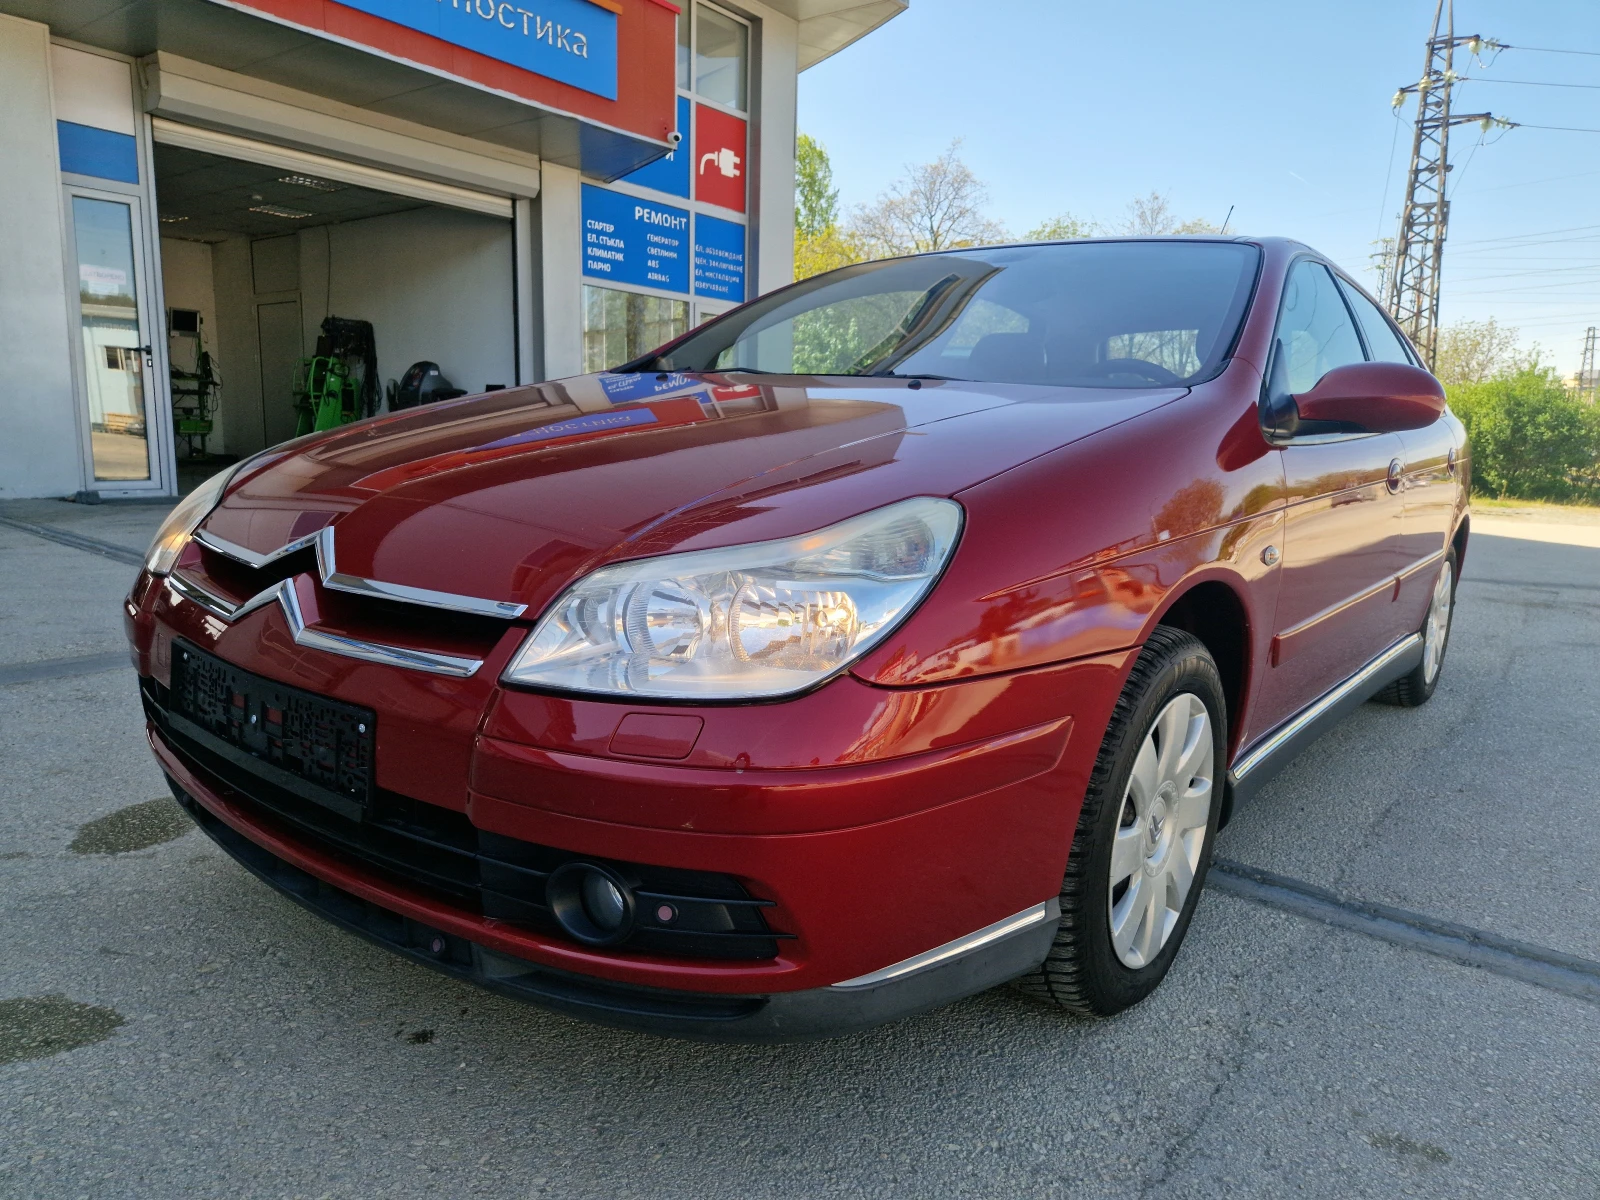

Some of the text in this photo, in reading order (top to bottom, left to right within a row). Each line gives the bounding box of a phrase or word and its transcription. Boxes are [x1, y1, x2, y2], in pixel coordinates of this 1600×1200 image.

[437, 0, 588, 58] остика
[635, 206, 687, 231] РЕМОНТ
[587, 219, 615, 233] СТАРТЕР
[599, 236, 624, 249] СТЪКЛА
[647, 233, 679, 247] ГЕНЕРАТОР
[587, 247, 624, 262] КЛИМАТИК
[647, 246, 678, 260] СВЕТЛИНИ
[588, 260, 611, 272] ПАРНО
[648, 259, 659, 269] ABS
[648, 272, 669, 283] AIRBAG
